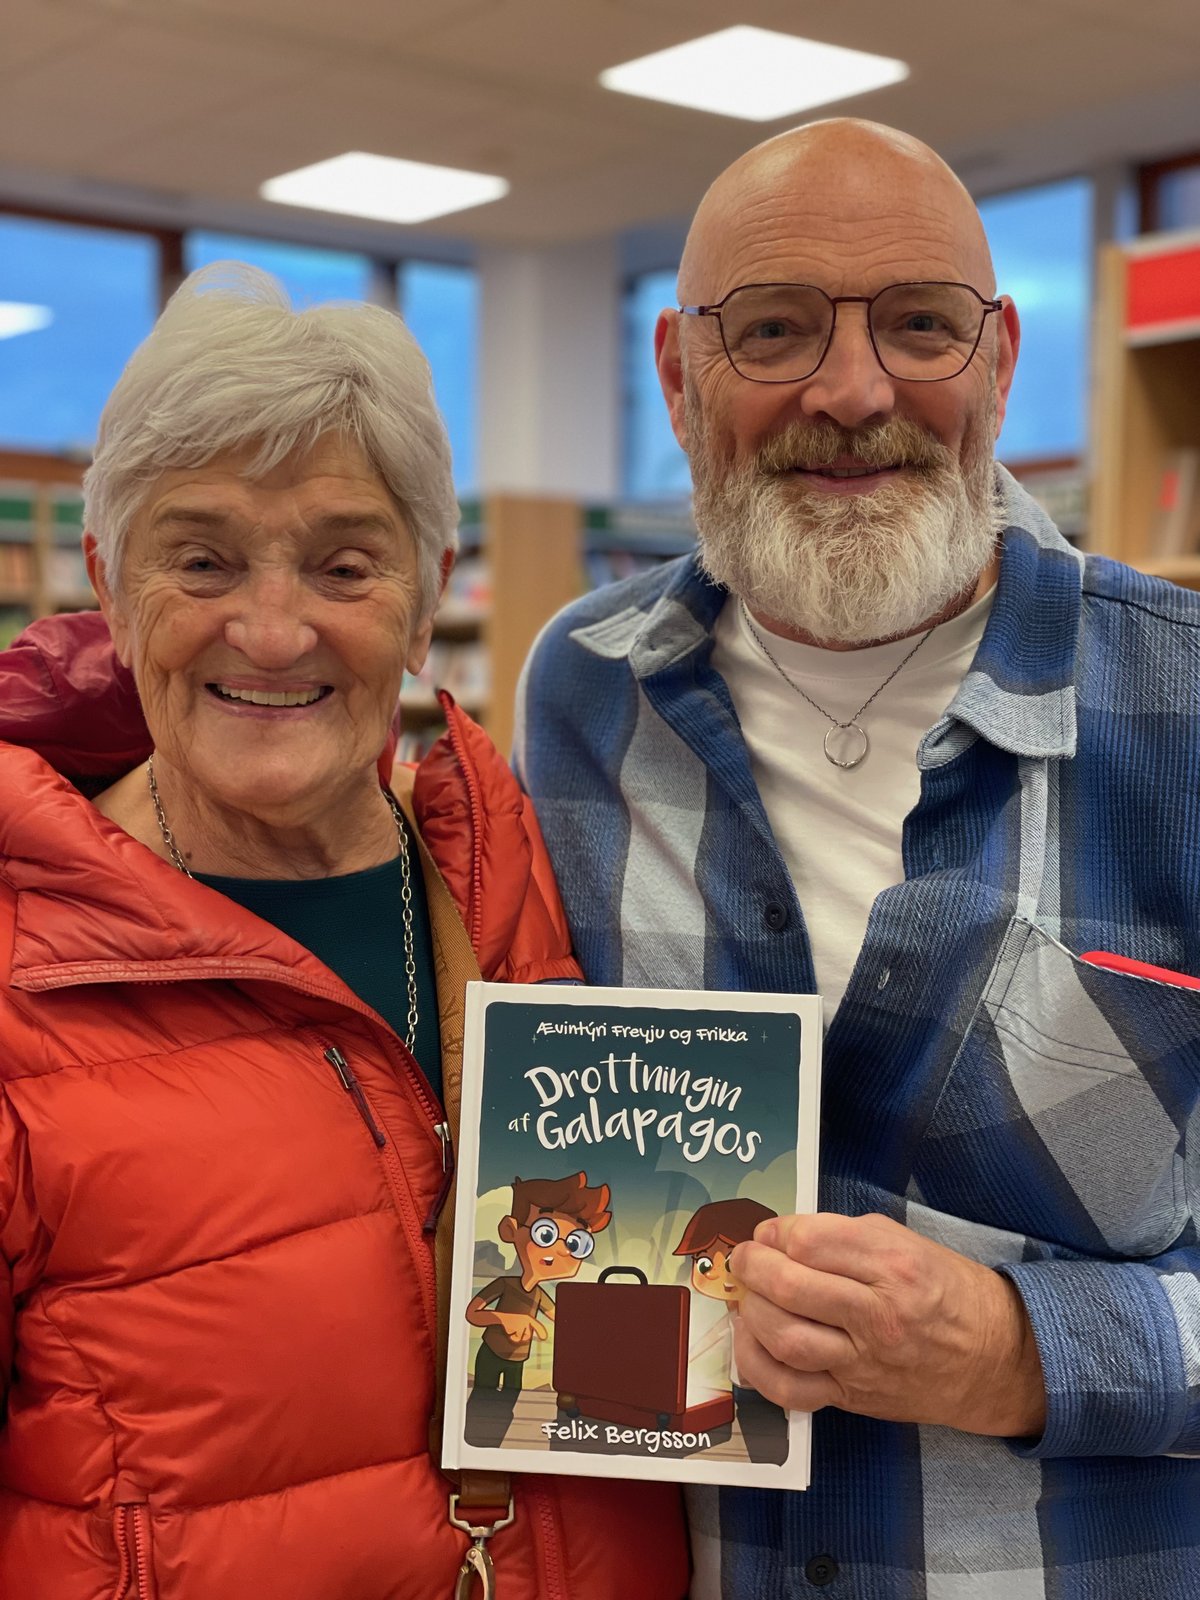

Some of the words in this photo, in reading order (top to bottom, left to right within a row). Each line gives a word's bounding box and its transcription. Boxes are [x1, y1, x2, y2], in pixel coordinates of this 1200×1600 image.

[536, 1021, 607, 1042] Ævintýri
[611, 1025, 665, 1043] Freyju
[670, 1028, 692, 1044] og
[696, 1027, 749, 1043] Frikka
[524, 1052, 742, 1112] Drottningin
[508, 1113, 531, 1133] af
[536, 1097, 762, 1163] Galapagos
[541, 1420, 599, 1441] Felix
[605, 1425, 711, 1453] Bergsson
